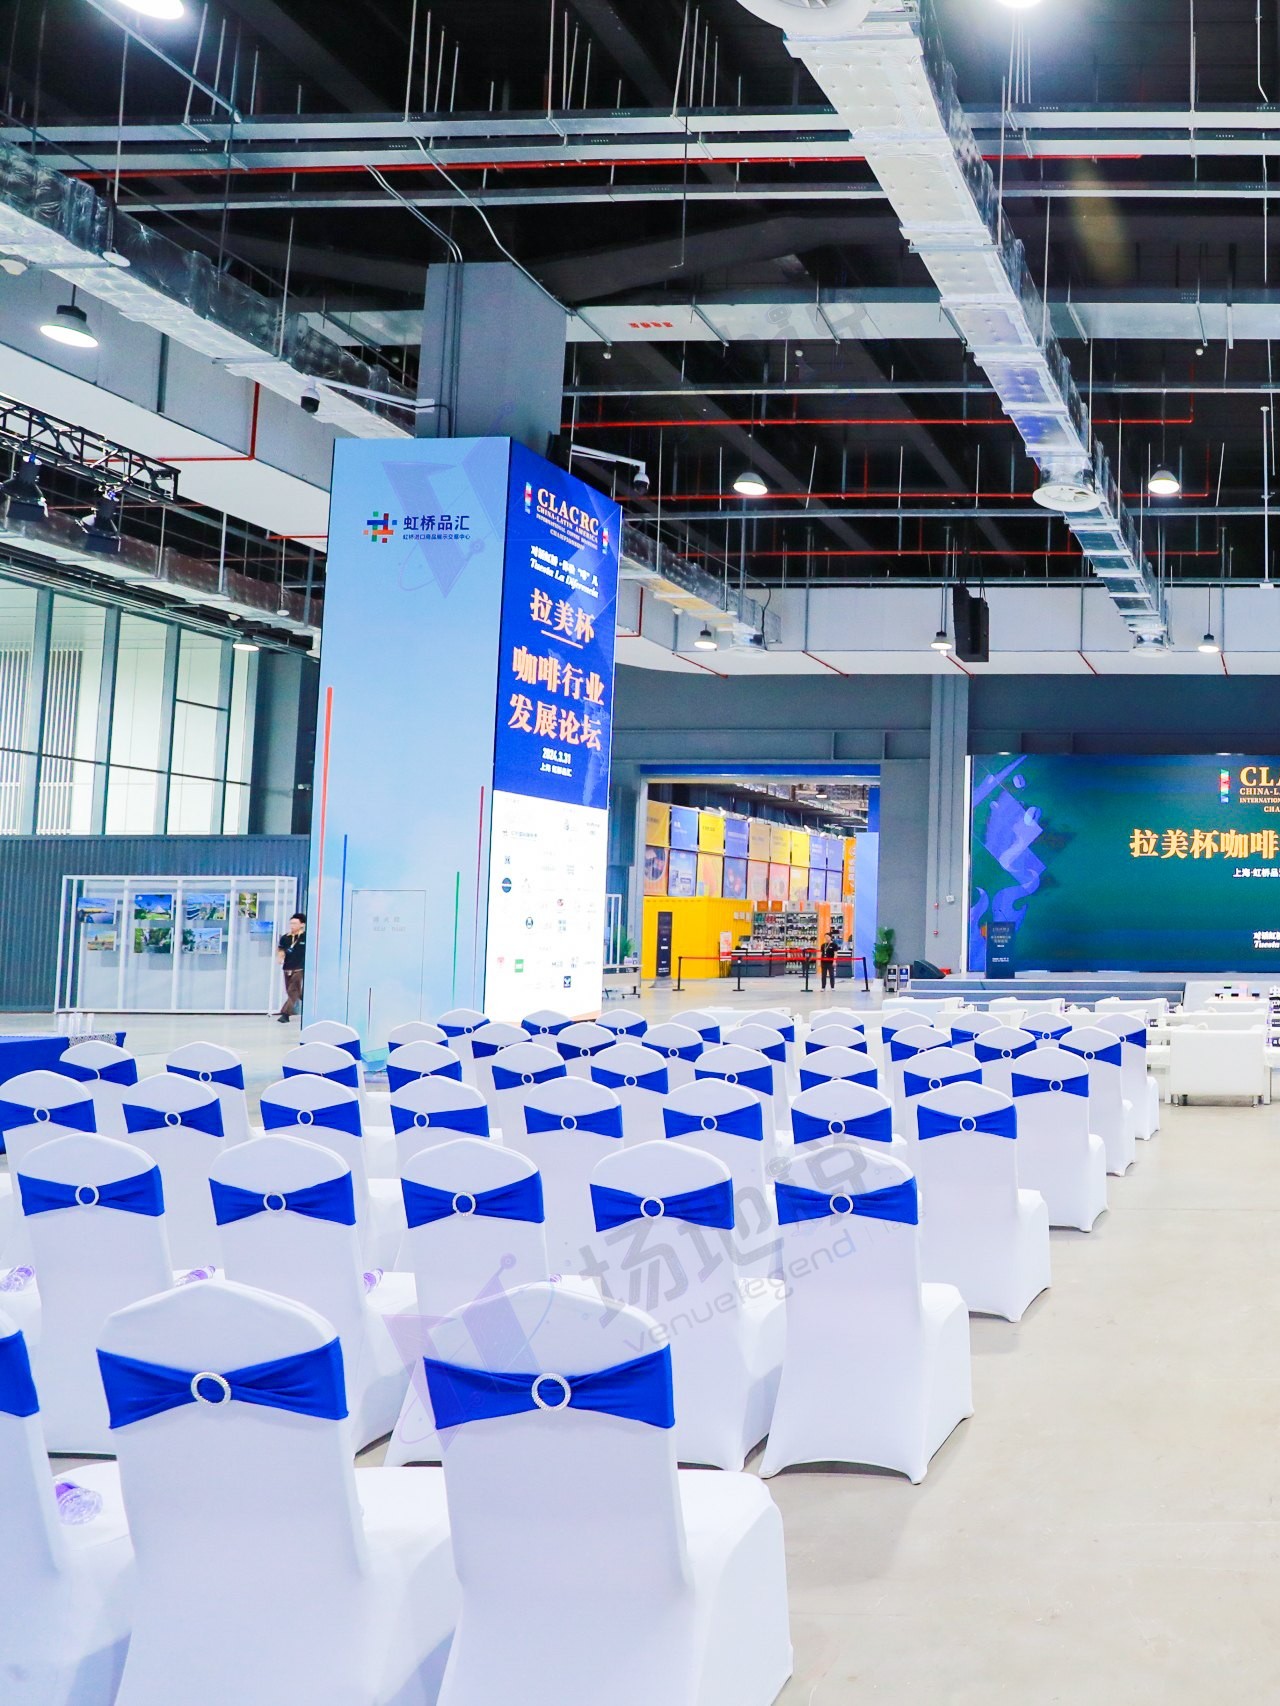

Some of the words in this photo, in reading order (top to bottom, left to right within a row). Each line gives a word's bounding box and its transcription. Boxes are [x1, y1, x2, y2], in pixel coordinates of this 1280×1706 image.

[403, 515, 470, 531] 虹桥品汇
[537, 488, 599, 536] CLACRC
[575, 525, 599, 543] AMERICA
[530, 587, 596, 644] 拉美杯
[512, 645, 605, 706] 咖啡行业
[507, 693, 602, 751] 发展论坛
